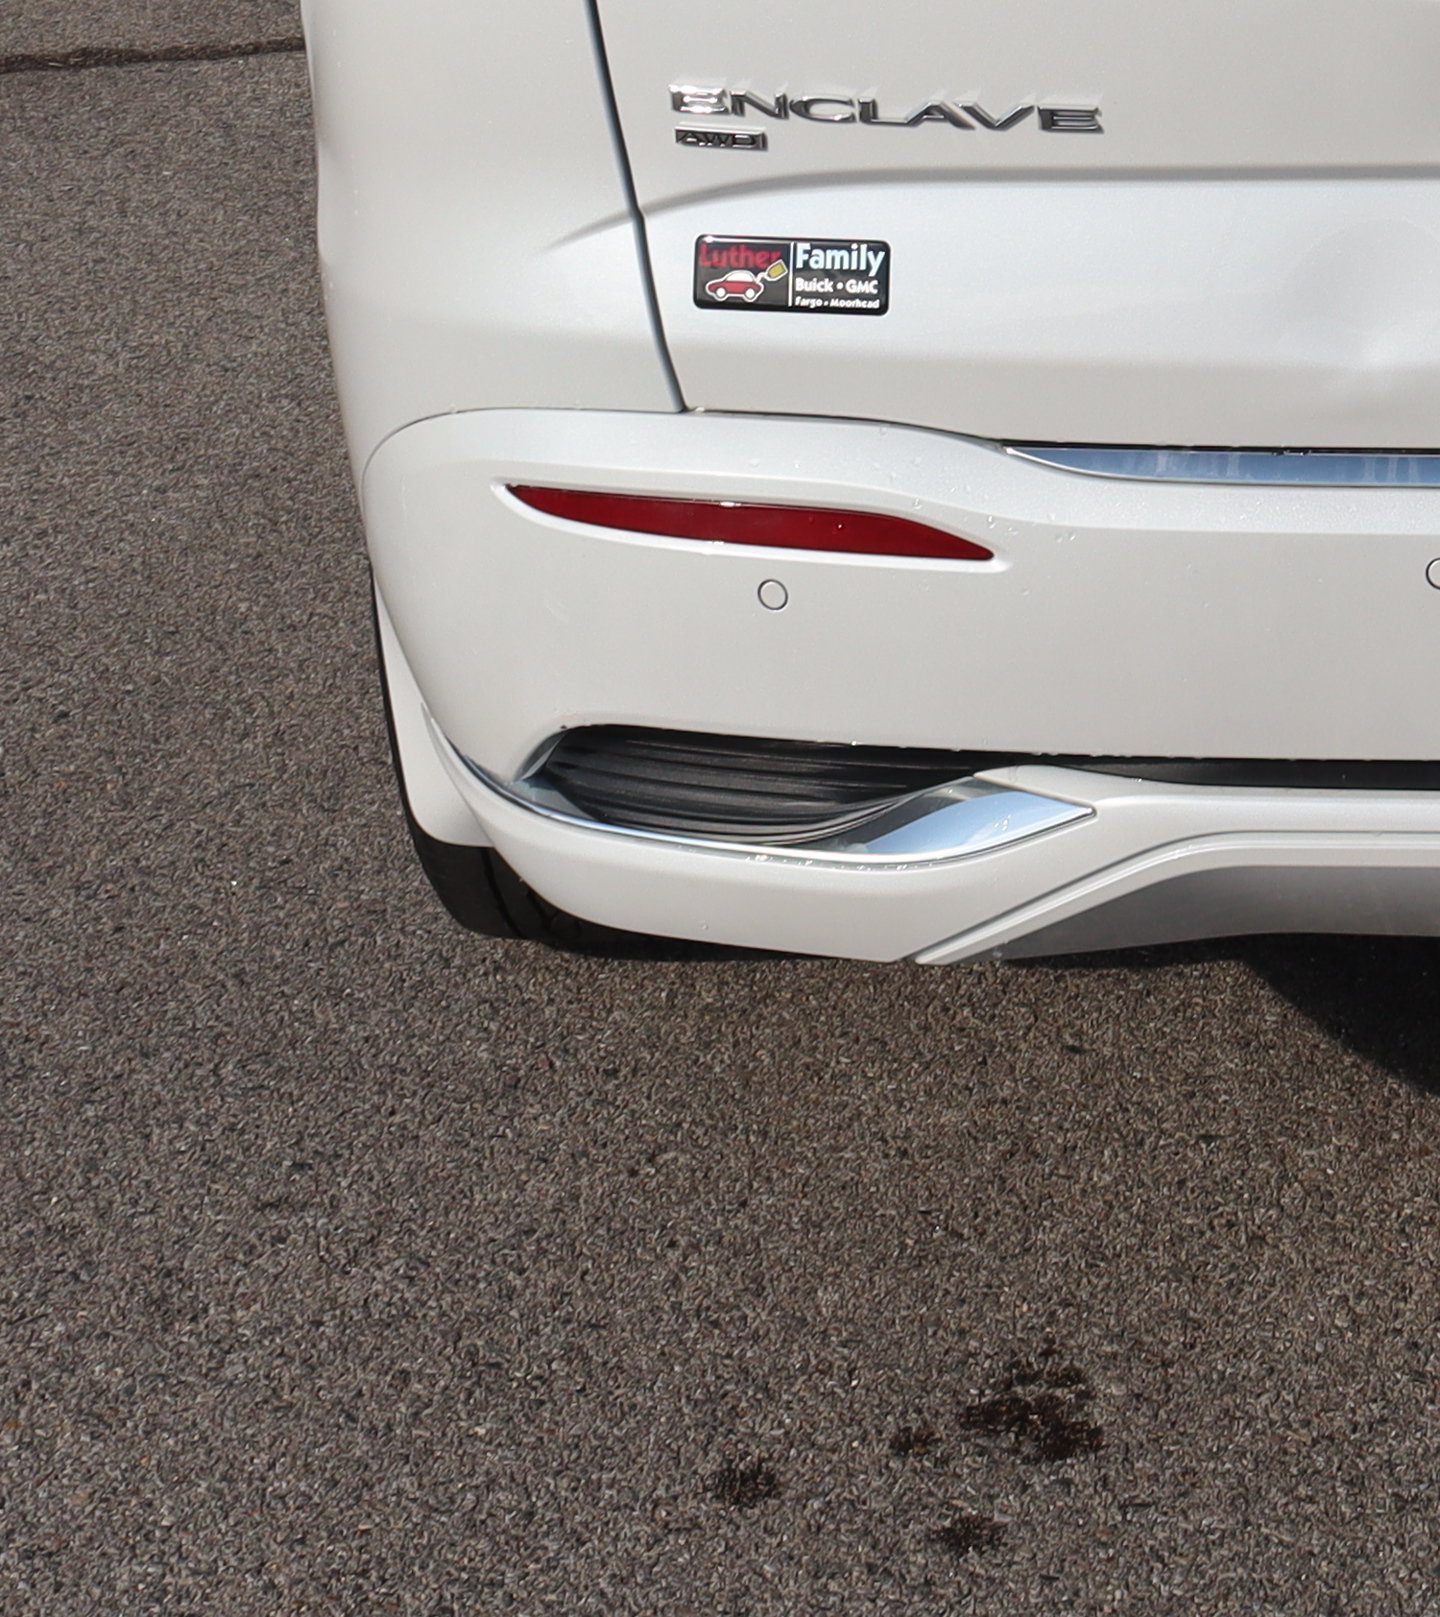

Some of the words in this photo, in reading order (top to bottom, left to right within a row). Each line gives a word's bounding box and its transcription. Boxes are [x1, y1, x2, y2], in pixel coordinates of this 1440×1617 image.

[669, 84, 1105, 133] ENCLAVE
[676, 130, 759, 150] AWD
[698, 243, 783, 269] Luther
[795, 243, 886, 276] Family
[795, 277, 834, 293] Buick
[845, 280, 879, 294] GMC
[795, 298, 823, 308] Fargo
[830, 298, 880, 309] Moorhead
